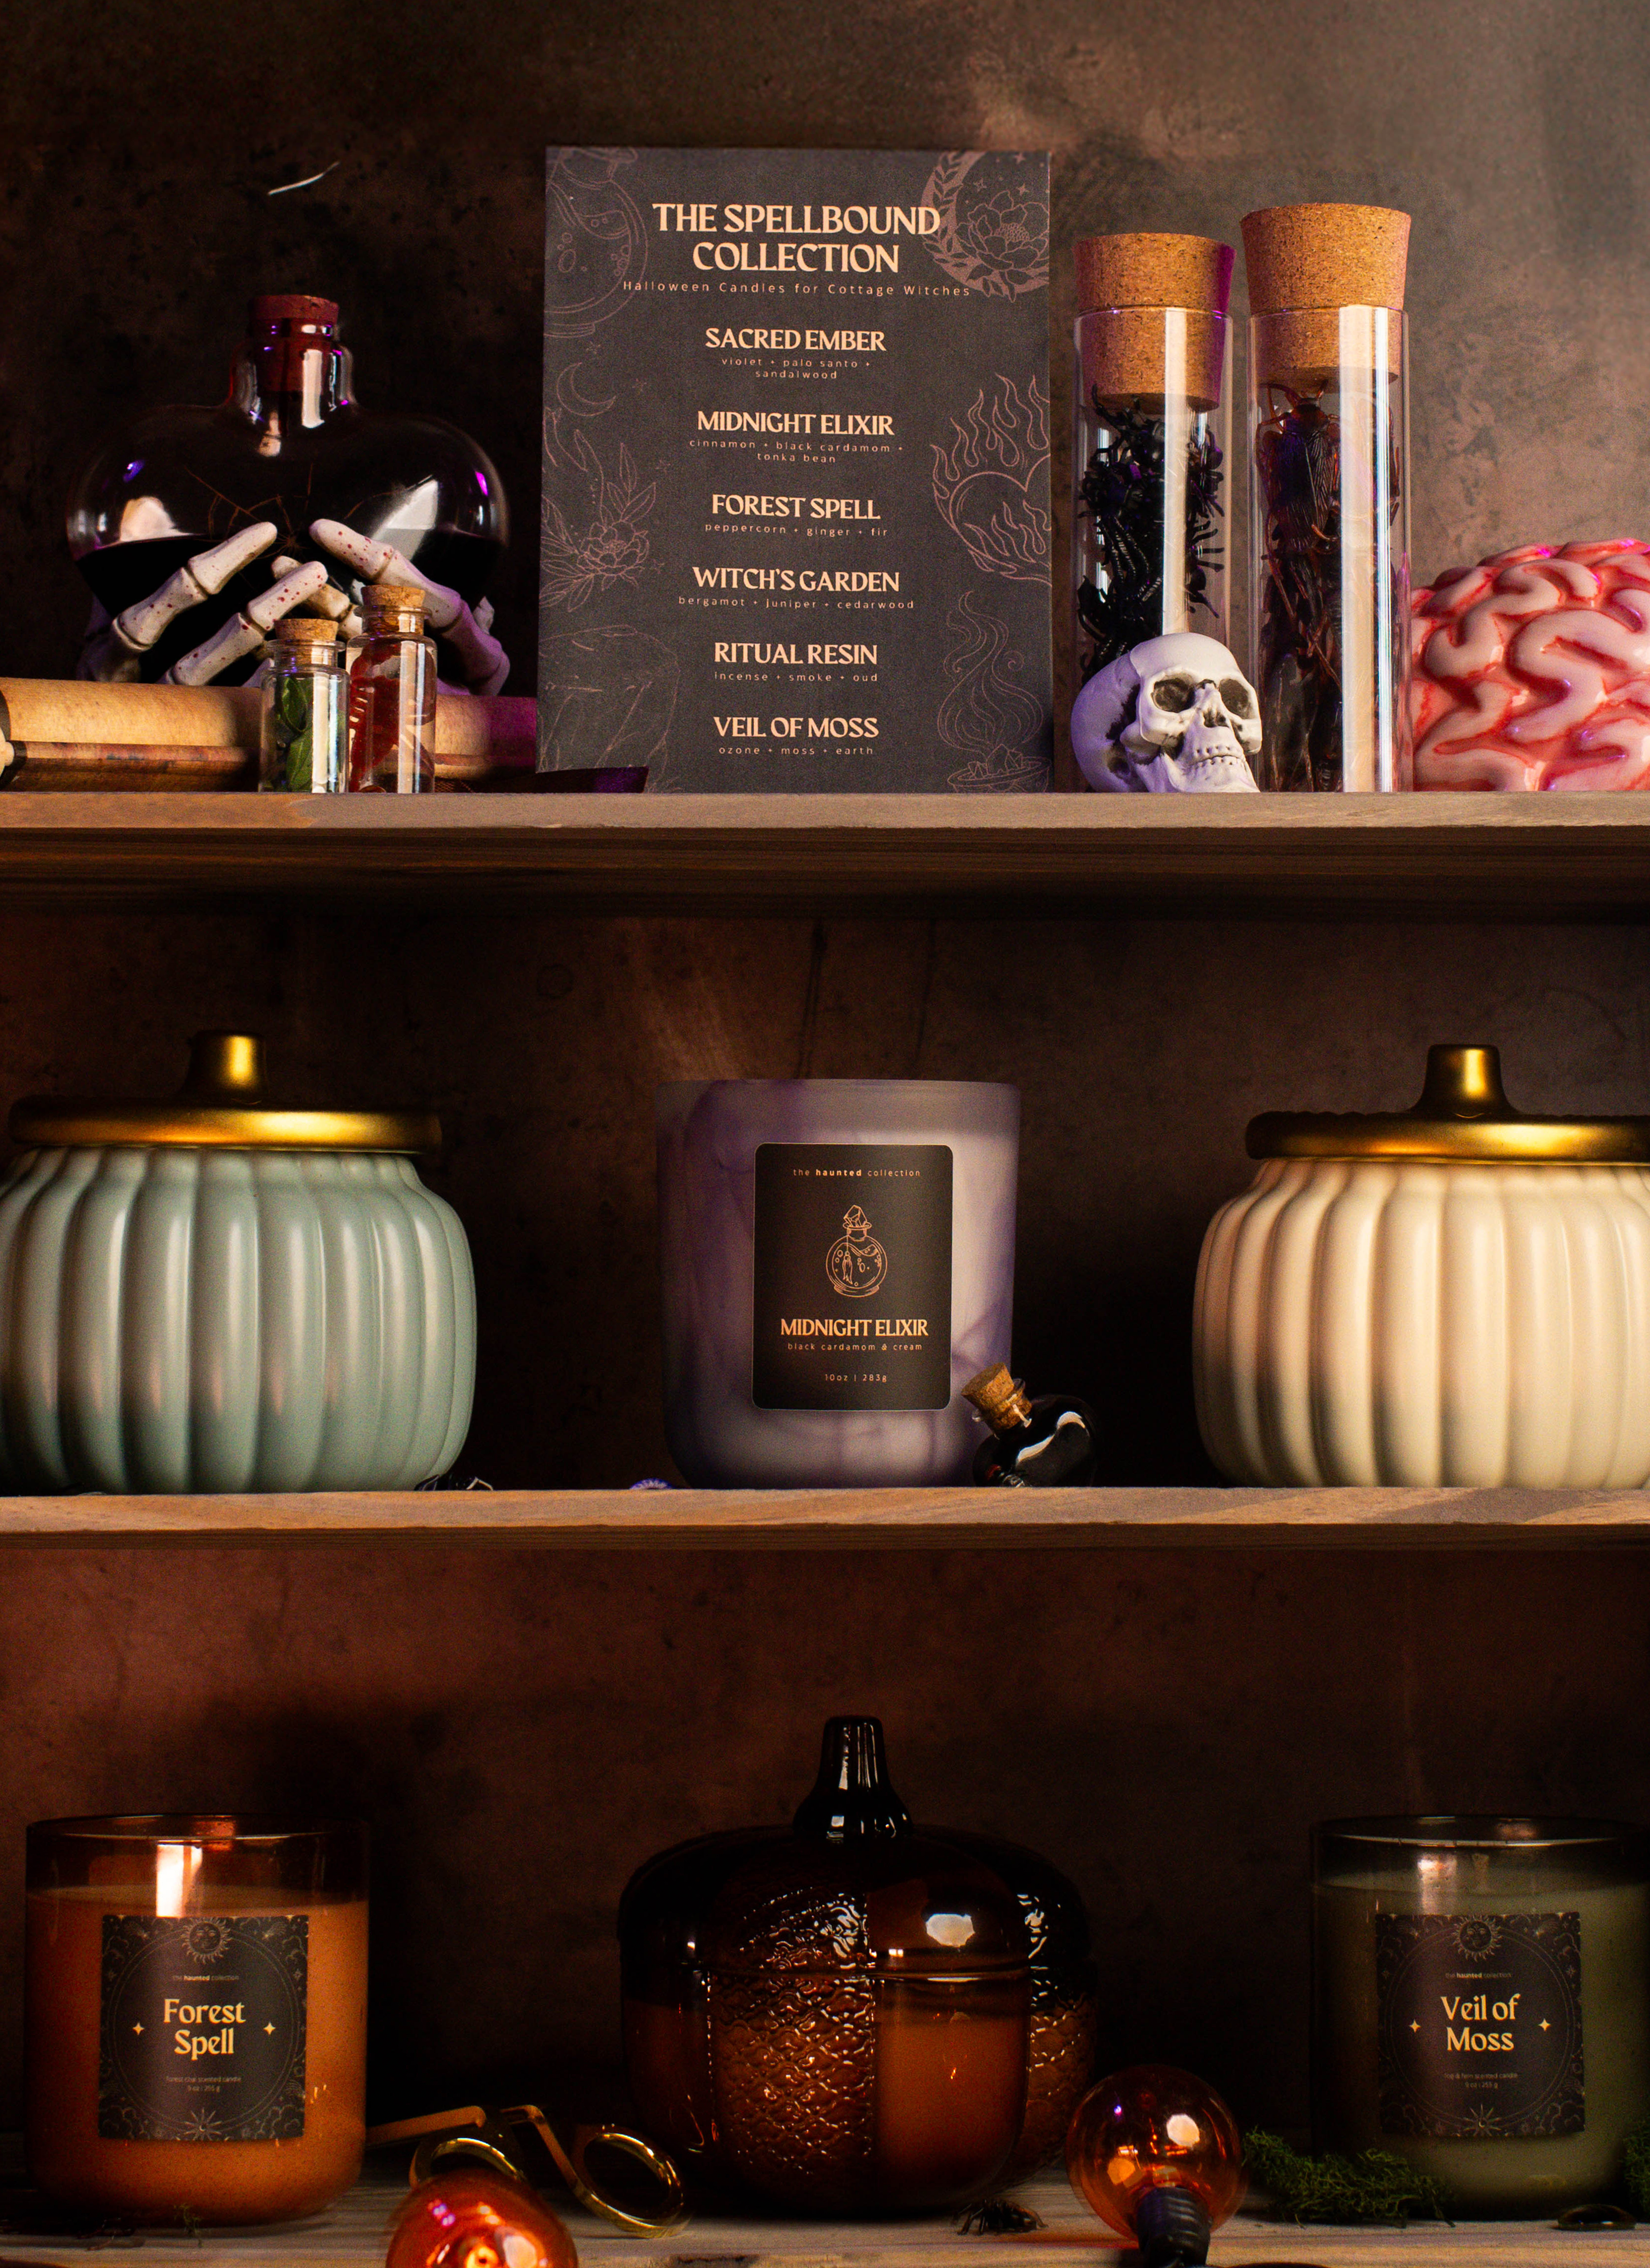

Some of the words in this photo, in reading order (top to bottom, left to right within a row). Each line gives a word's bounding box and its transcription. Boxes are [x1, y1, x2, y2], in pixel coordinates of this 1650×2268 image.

[652, 203, 717, 231] THE
[724, 204, 940, 234] SPELLBOUND
[693, 242, 899, 272] COLLECTION
[624, 281, 709, 291] Halloween
[719, 282, 785, 293] Candles
[795, 284, 818, 293] for
[828, 284, 893, 297] Cottage
[904, 283, 972, 296] Witches
[706, 328, 801, 349] SACRED
[806, 330, 886, 351] EMBER
[756, 370, 836, 379] sandalwood
[698, 411, 816, 433] MIDNIGHT
[821, 414, 894, 435] ELIXIR
[777, 442, 811, 450] black
[712, 494, 806, 517] FOREST
[811, 498, 881, 519] SPELL
[706, 524, 786, 533] peppercorn
[807, 528, 849, 537] ginger
[692, 567, 795, 590] WITCH'S
[800, 571, 899, 592] GARDEN
[679, 596, 744, 607] bergamot
[766, 598, 815, 609] juniper
[715, 642, 803, 664] RITUAL
[808, 644, 877, 664] RESIN
[715, 672, 768, 680] incense
[713, 717, 766, 737] VEIL
[771, 717, 803, 737] OF
[808, 718, 879, 738] MOSS
[782, 1319, 872, 1336] MIDNIGHT
[876, 1319, 928, 1336] ELIXIR
[863, 1374, 886, 1382] 283g
[164, 1999, 245, 2024] Forest
[1441, 1995, 1487, 2020] Veil
[1493, 1994, 1520, 2020] of
[174, 2028, 233, 2061] Spell
[1447, 2028, 1514, 2051] Moss
